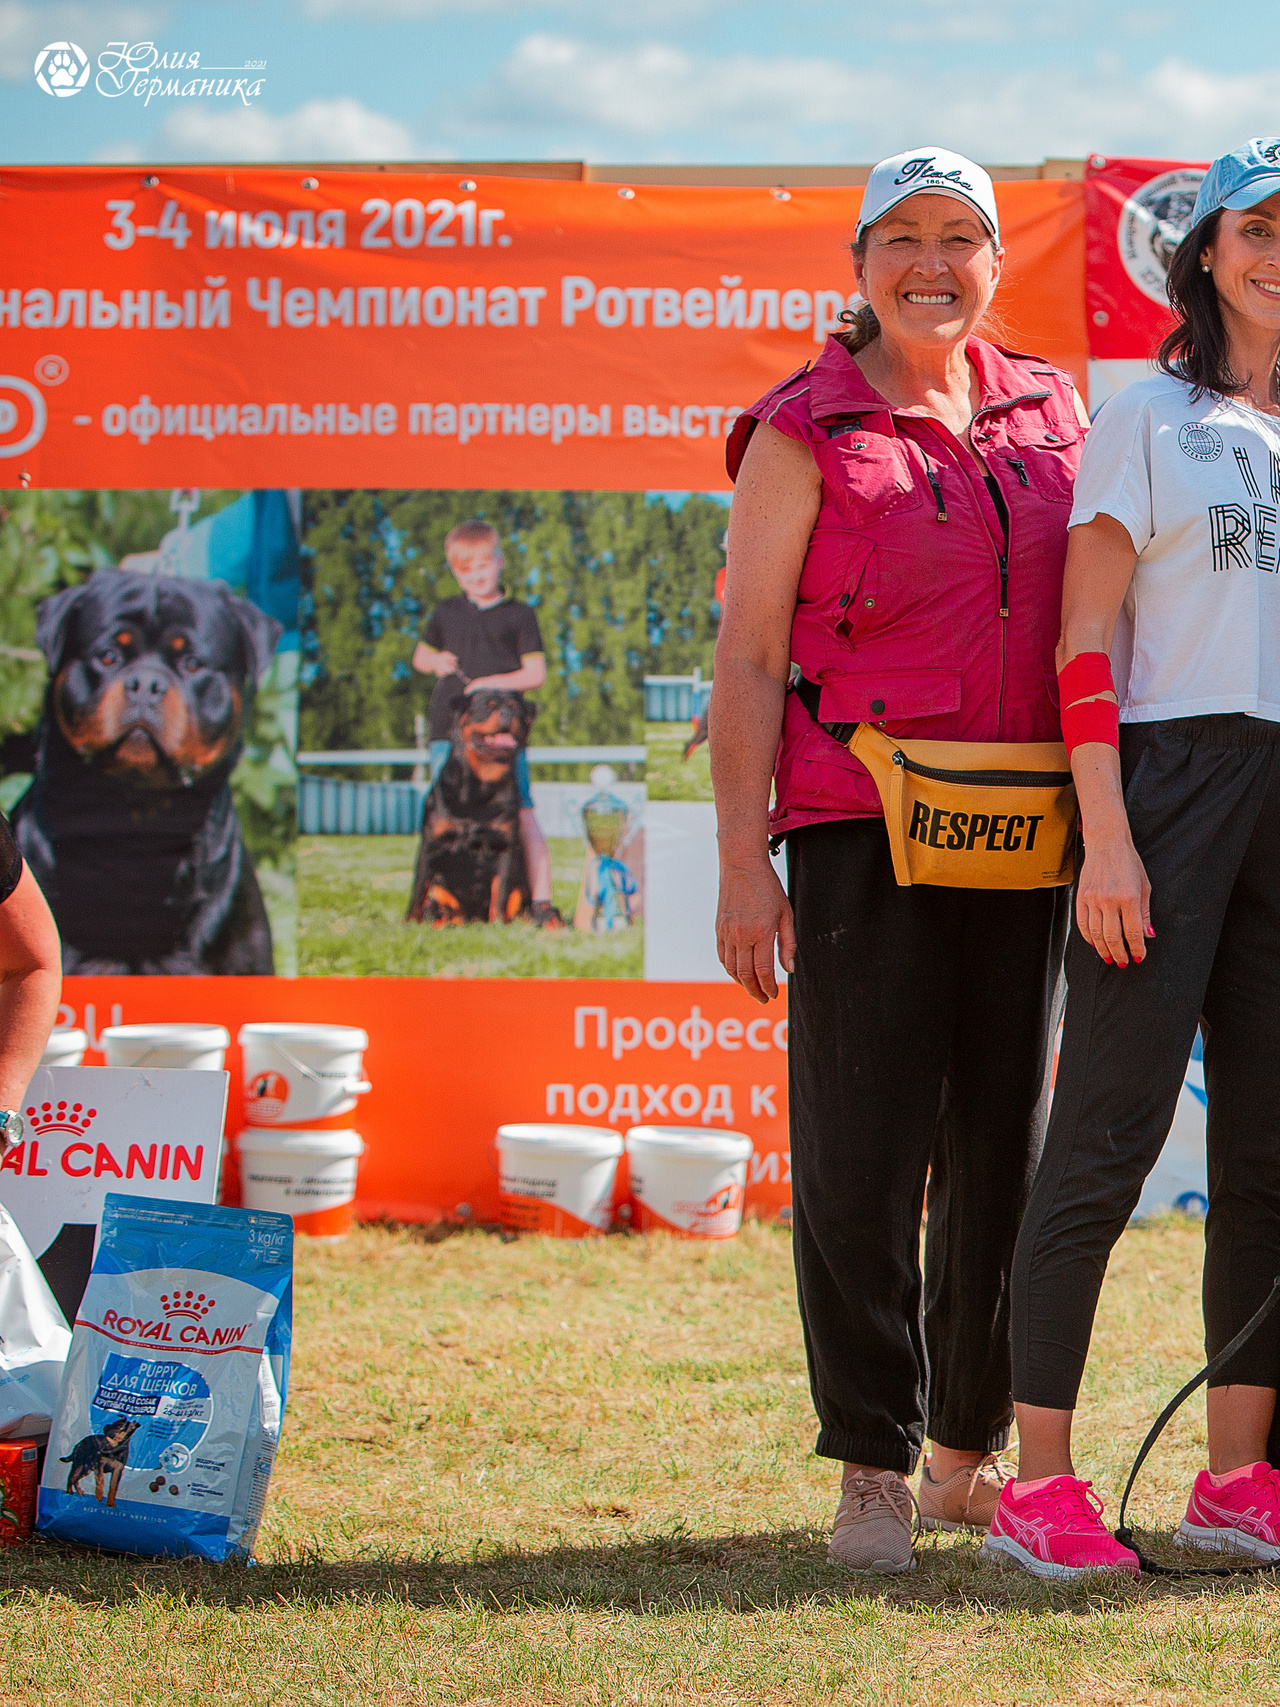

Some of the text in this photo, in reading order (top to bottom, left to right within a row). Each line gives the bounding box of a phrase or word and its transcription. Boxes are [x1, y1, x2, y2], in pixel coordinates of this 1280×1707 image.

[893, 156, 974, 191] Italia
[102, 198, 513, 251] 3-4 июля 2021г.
[0, 275, 232, 329] нальный
[245, 283, 548, 329] Чемпионат
[101, 394, 399, 445] официальные
[407, 402, 612, 446] партнеры
[1232, 446, 1263, 499] I
[908, 799, 1045, 852] RESPECT
[545, 1083, 778, 1125] подход к
[61, 1141, 204, 1181] CANIN
[249, 1229, 256, 1243] 3
[102, 1308, 248, 1346] ROYAL CANIN
[106, 1372, 198, 1397] ДЛЯ ЩЕНКОВ
[138, 1362, 180, 1378] PUPPY
